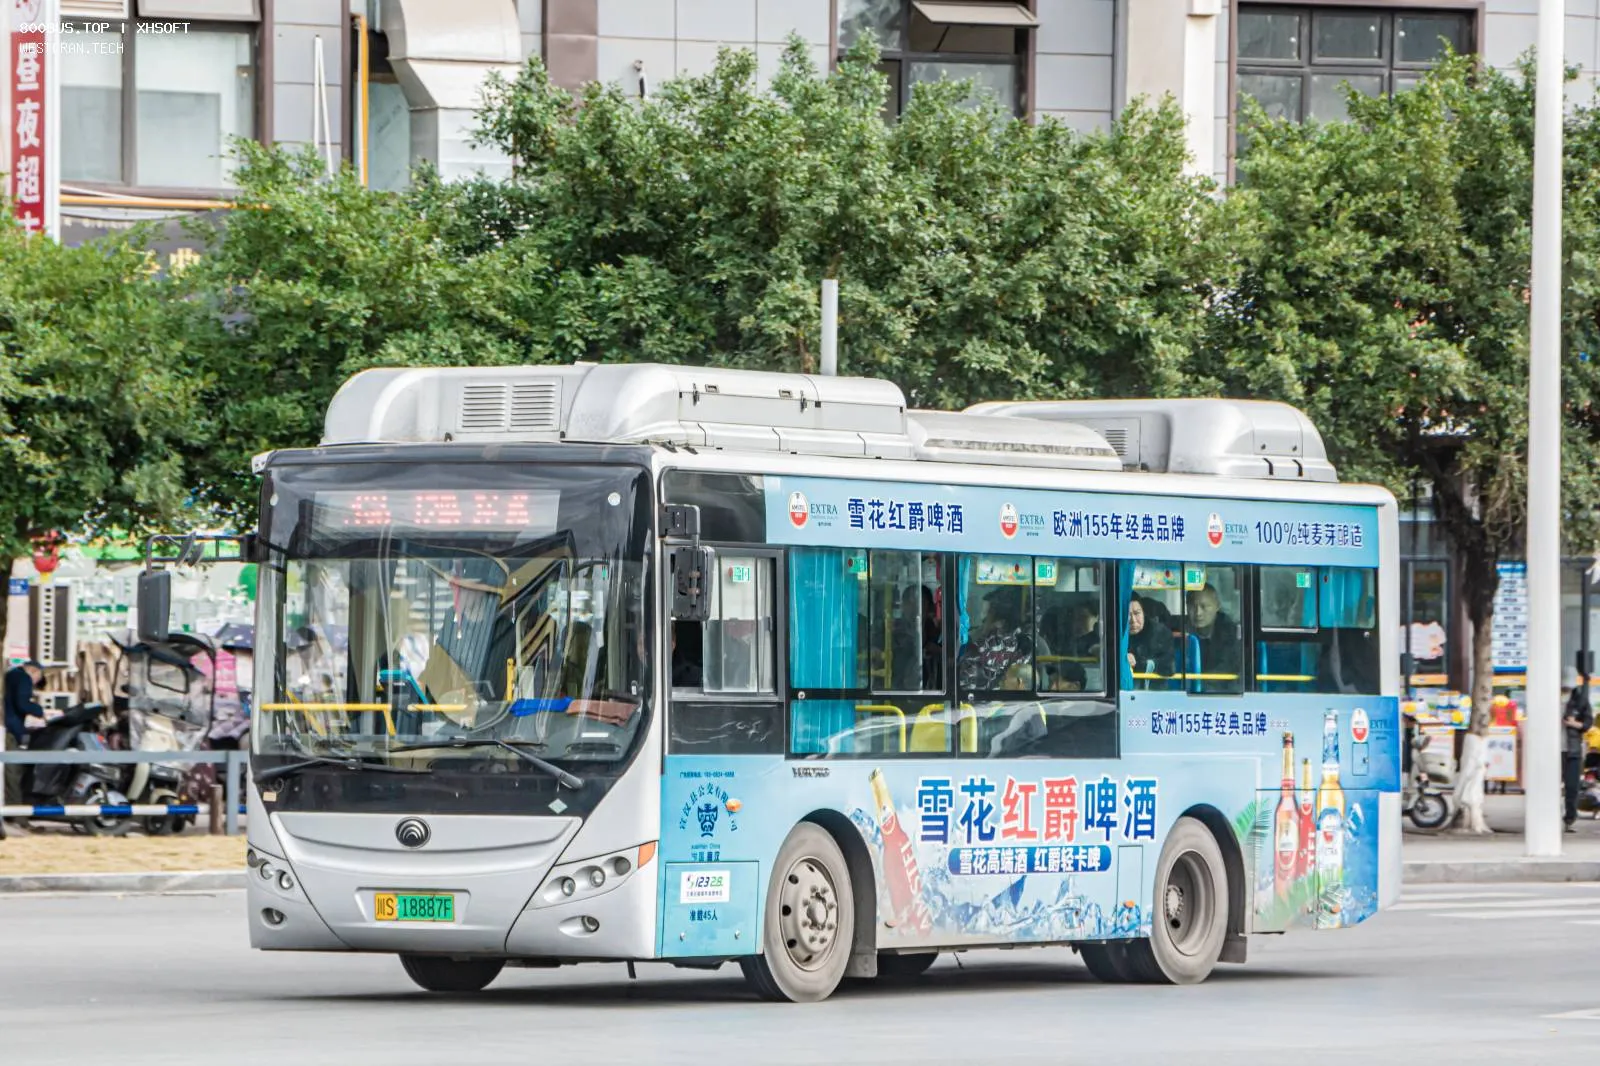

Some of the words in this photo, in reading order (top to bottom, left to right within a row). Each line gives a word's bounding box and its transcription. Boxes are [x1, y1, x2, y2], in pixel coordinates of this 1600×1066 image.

[810, 503, 838, 515] EXTRA
[848, 498, 963, 533] 雪花红爵啤酒
[1020, 514, 1045, 525] EXTRA
[1053, 510, 1185, 541] 欧洲155年经典品牌
[1225, 523, 1249, 534] EXTRA
[1255, 521, 1362, 547] 100%纯麦芽酿造
[1151, 711, 1267, 736] 欧洲155年经典品牌
[917, 777, 1157, 844] 雪花红爵啤酒
[959, 848, 1027, 874] 雪花高端酒
[1034, 846, 1101, 873] 红爵轻卡啤
